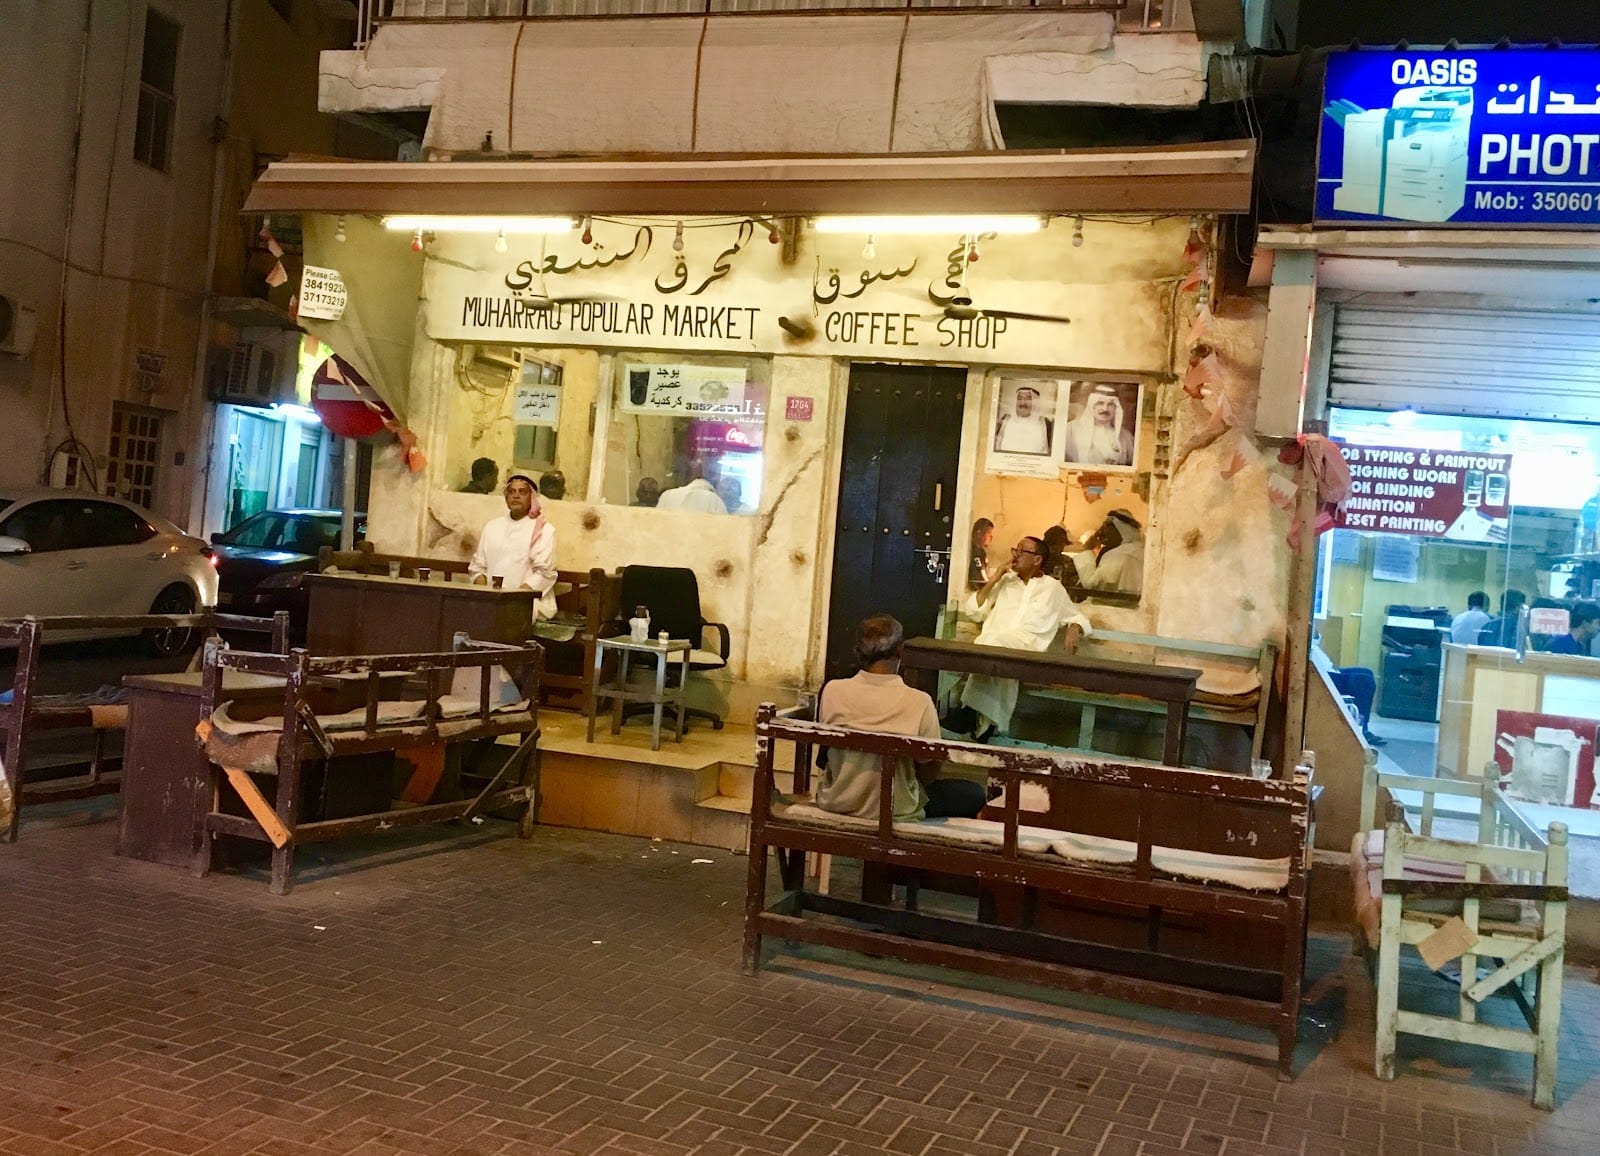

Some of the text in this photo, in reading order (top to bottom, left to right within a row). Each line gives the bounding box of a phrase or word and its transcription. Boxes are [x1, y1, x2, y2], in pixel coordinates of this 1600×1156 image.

[1391, 58, 1477, 85] OASIS
[1478, 133, 1600, 175] PHOT
[1474, 190, 1525, 210] Mob:
[505, 226, 653, 297] الشعبي
[655, 219, 754, 296] المحرق
[306, 268, 328, 279] Please
[813, 257, 918, 304] سوق
[303, 292, 345, 307] 37173219
[462, 296, 1008, 349] MUHARRAQ POPULAR MARKET COFFEE SHOP
[656, 367, 680, 379] يوجد
[653, 380, 681, 392] عصير
[1340, 448, 1359, 461] OB
[1364, 450, 1415, 464] TYPING
[1419, 452, 1431, 466] &
[1349, 465, 1457, 484] SIGNING WORK
[1351, 481, 1435, 499] OK BINDING
[1346, 497, 1415, 513] MINATION
[1345, 513, 1377, 528] FSET
